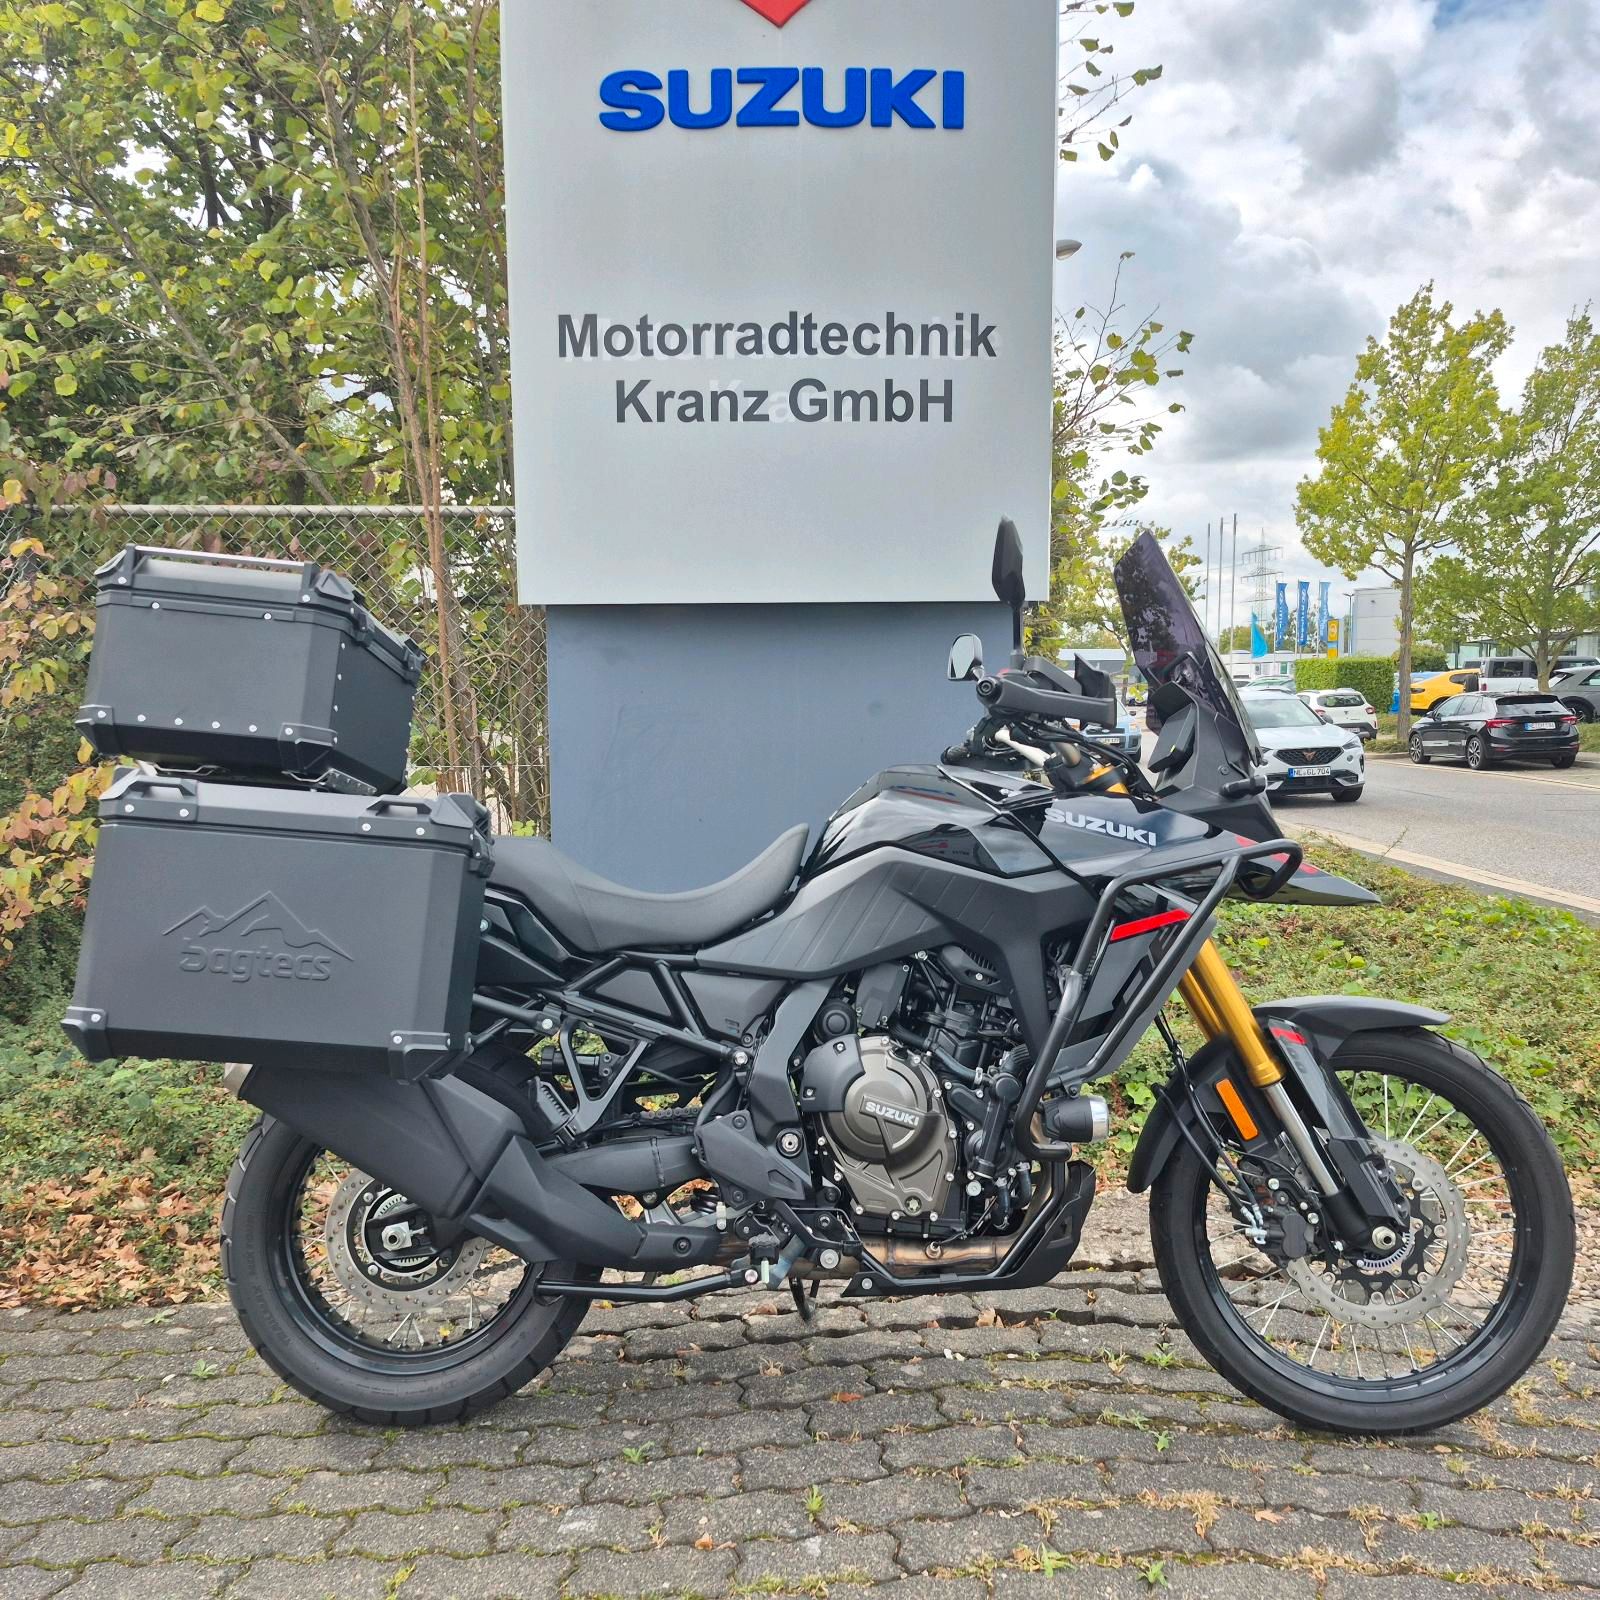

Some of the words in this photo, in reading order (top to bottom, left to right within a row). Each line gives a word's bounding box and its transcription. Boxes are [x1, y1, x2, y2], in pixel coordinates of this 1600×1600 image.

[599, 67, 965, 131] SUZUKI
[558, 311, 998, 359] Motorradtechnik
[615, 379, 771, 423] Kranz
[789, 378, 954, 423] GmbH
[1044, 807, 1157, 847] SUZUKI
[865, 1101, 920, 1126] SUZUKI
